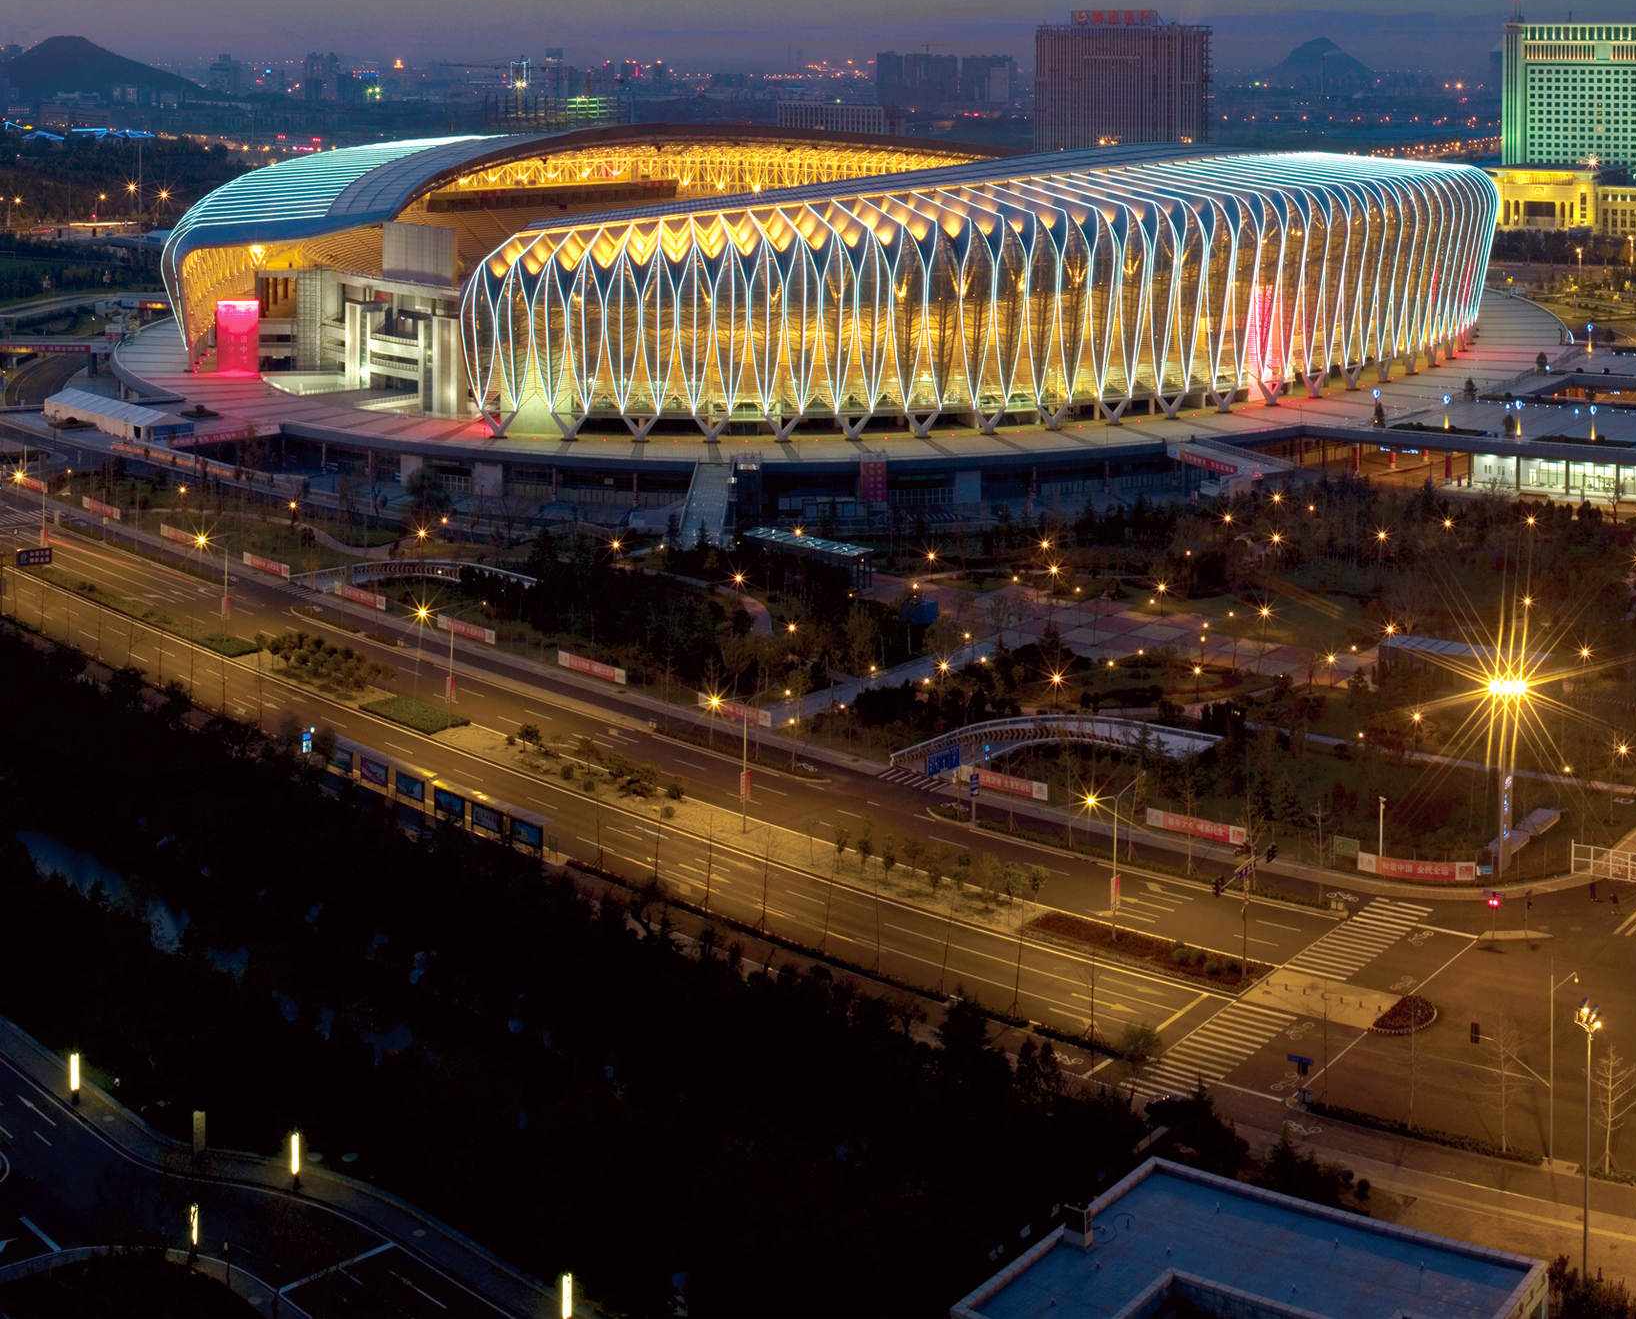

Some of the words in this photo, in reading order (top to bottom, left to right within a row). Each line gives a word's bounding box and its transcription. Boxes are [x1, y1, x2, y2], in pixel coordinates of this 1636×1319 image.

[1382, 861, 1413, 873] 和谐中国
[1416, 865, 1449, 876] 全民全运
